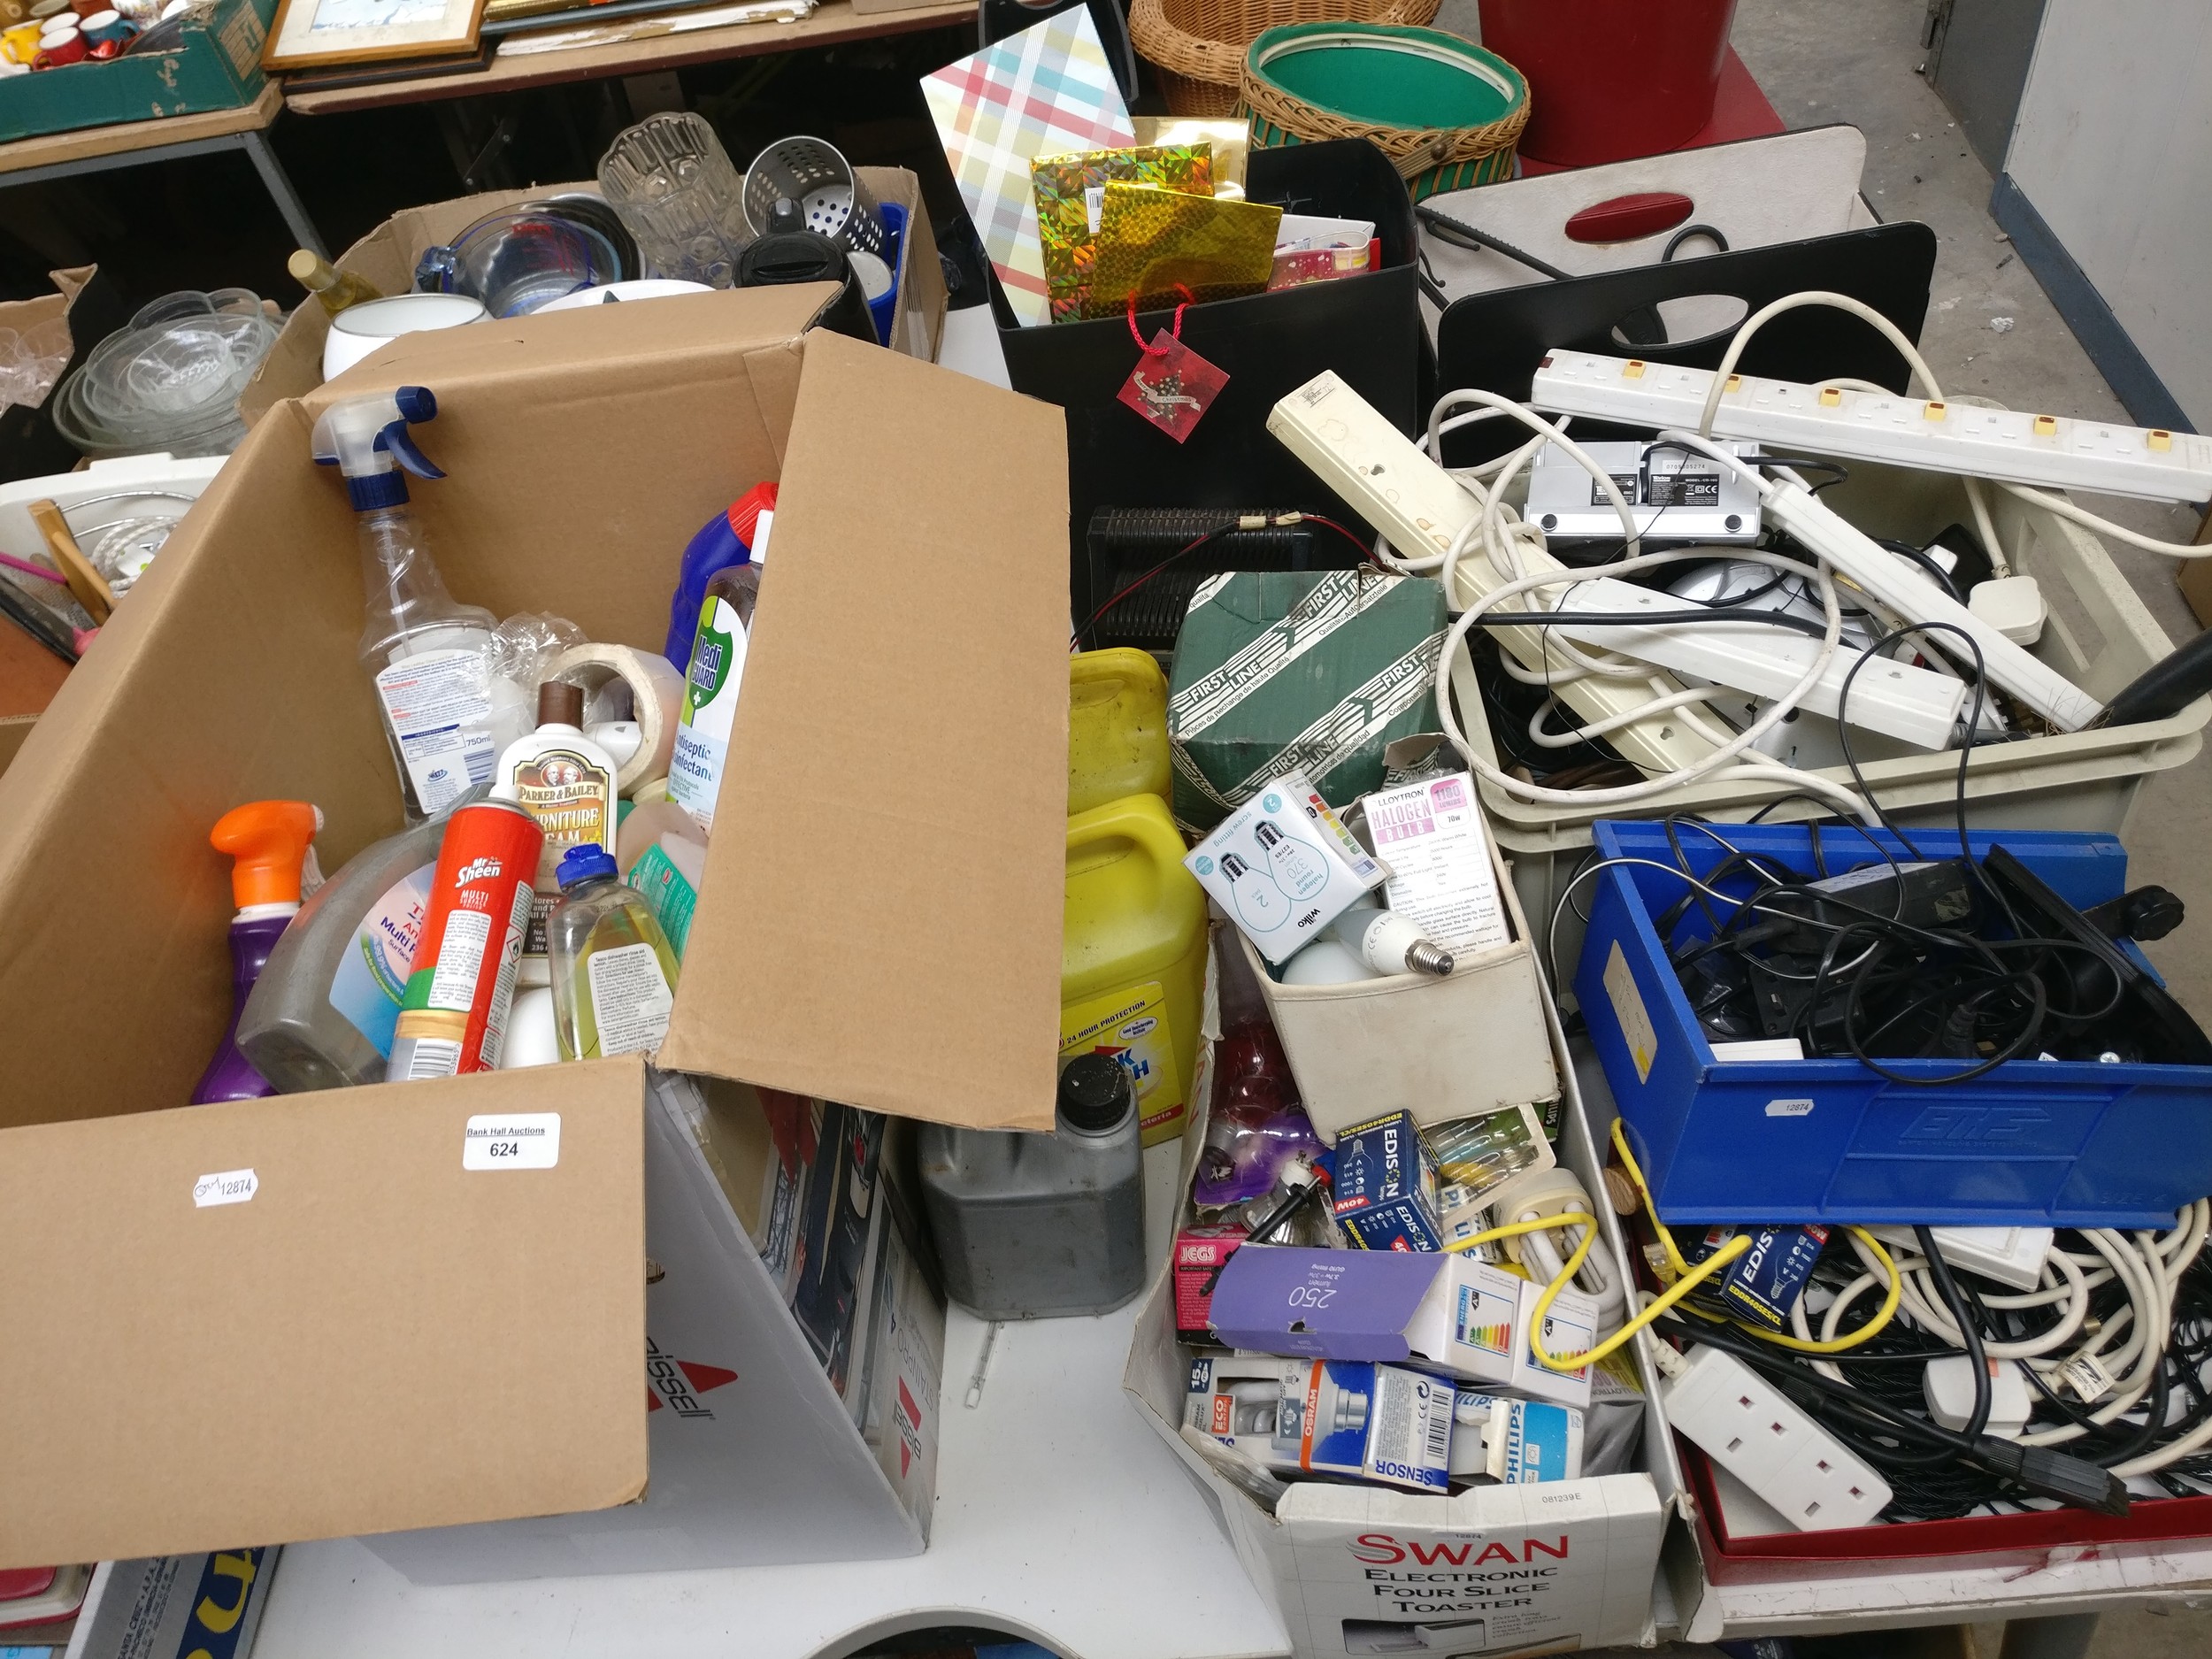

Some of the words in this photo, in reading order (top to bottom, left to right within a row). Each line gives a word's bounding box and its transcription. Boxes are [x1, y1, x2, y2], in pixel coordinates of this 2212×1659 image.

[1303, 576, 1339, 618] FIRST
[1341, 576, 1378, 602] LINE
[695, 634, 723, 672] Medi
[691, 662, 718, 691] GUARD
[1189, 670, 1227, 703] FIRST
[1229, 660, 1263, 691] LINE
[1382, 654, 1422, 689] FIRST
[1387, 685, 1425, 718] Componenti
[465, 734, 491, 747] 750ml
[1268, 743, 1307, 778] FIRST
[1309, 733, 1340, 766] LINE
[1309, 757, 1338, 784] tomotrices
[518, 785, 556, 802] PARKER
[557, 789, 564, 800] &
[564, 784, 599, 799] BAILEY
[1378, 787, 1425, 806] LLOYTRON
[1434, 785, 1461, 802] 1180
[536, 807, 600, 833] RNITURE
[1233, 810, 1252, 832] screw
[1371, 798, 1432, 830] HALOGEN
[1213, 829, 1234, 848] fitting
[1386, 820, 1425, 842] BULB
[472, 857, 487, 870] Mr
[1286, 857, 1309, 879] 370
[455, 864, 501, 888] Sheen
[1295, 869, 1314, 887] round
[1298, 872, 1324, 895] halogen
[460, 889, 489, 902] MULTI
[534, 896, 555, 905] tores
[1256, 894, 1269, 908] 2
[1297, 908, 1321, 928] wilko
[380, 916, 411, 947] Multi
[388, 938, 411, 964] Surface
[1066, 1034, 1078, 1045] 24
[1078, 1024, 1100, 1040] HOUR
[1100, 1000, 1147, 1028] PROTECTION
[466, 1127, 488, 1137] Bank
[490, 1126, 506, 1136] Hall
[508, 1125, 546, 1136] Auctions
[489, 1141, 518, 1157] 624
[1384, 1128, 1401, 1198] EDISON
[220, 1178, 252, 1196] 12874
[1336, 1197, 1365, 1211] 40W
[1395, 1205, 1432, 1252] EDISON
[1179, 1245, 1217, 1263] JEGS
[1742, 1231, 1775, 1284] EDIS
[1288, 1286, 1337, 1309] 250
[896, 1327, 933, 1412] STAINPRO
[1191, 1368, 1202, 1390] 15
[1215, 1399, 1225, 1431] ECO
[1304, 1388, 1318, 1438] OSRAM
[1506, 1403, 1522, 1484] PHILIPS
[1375, 1459, 1433, 1486] SENSOR
[1541, 1492, 1583, 1504] 081239E
[1348, 1533, 1570, 1567] SWAN
[1363, 1567, 1559, 1583] ELECTRONIC
[1372, 1584, 1455, 1599] FOUR
[1463, 1582, 1550, 1598] SLICE
[1391, 1597, 1533, 1614] TOASTER
